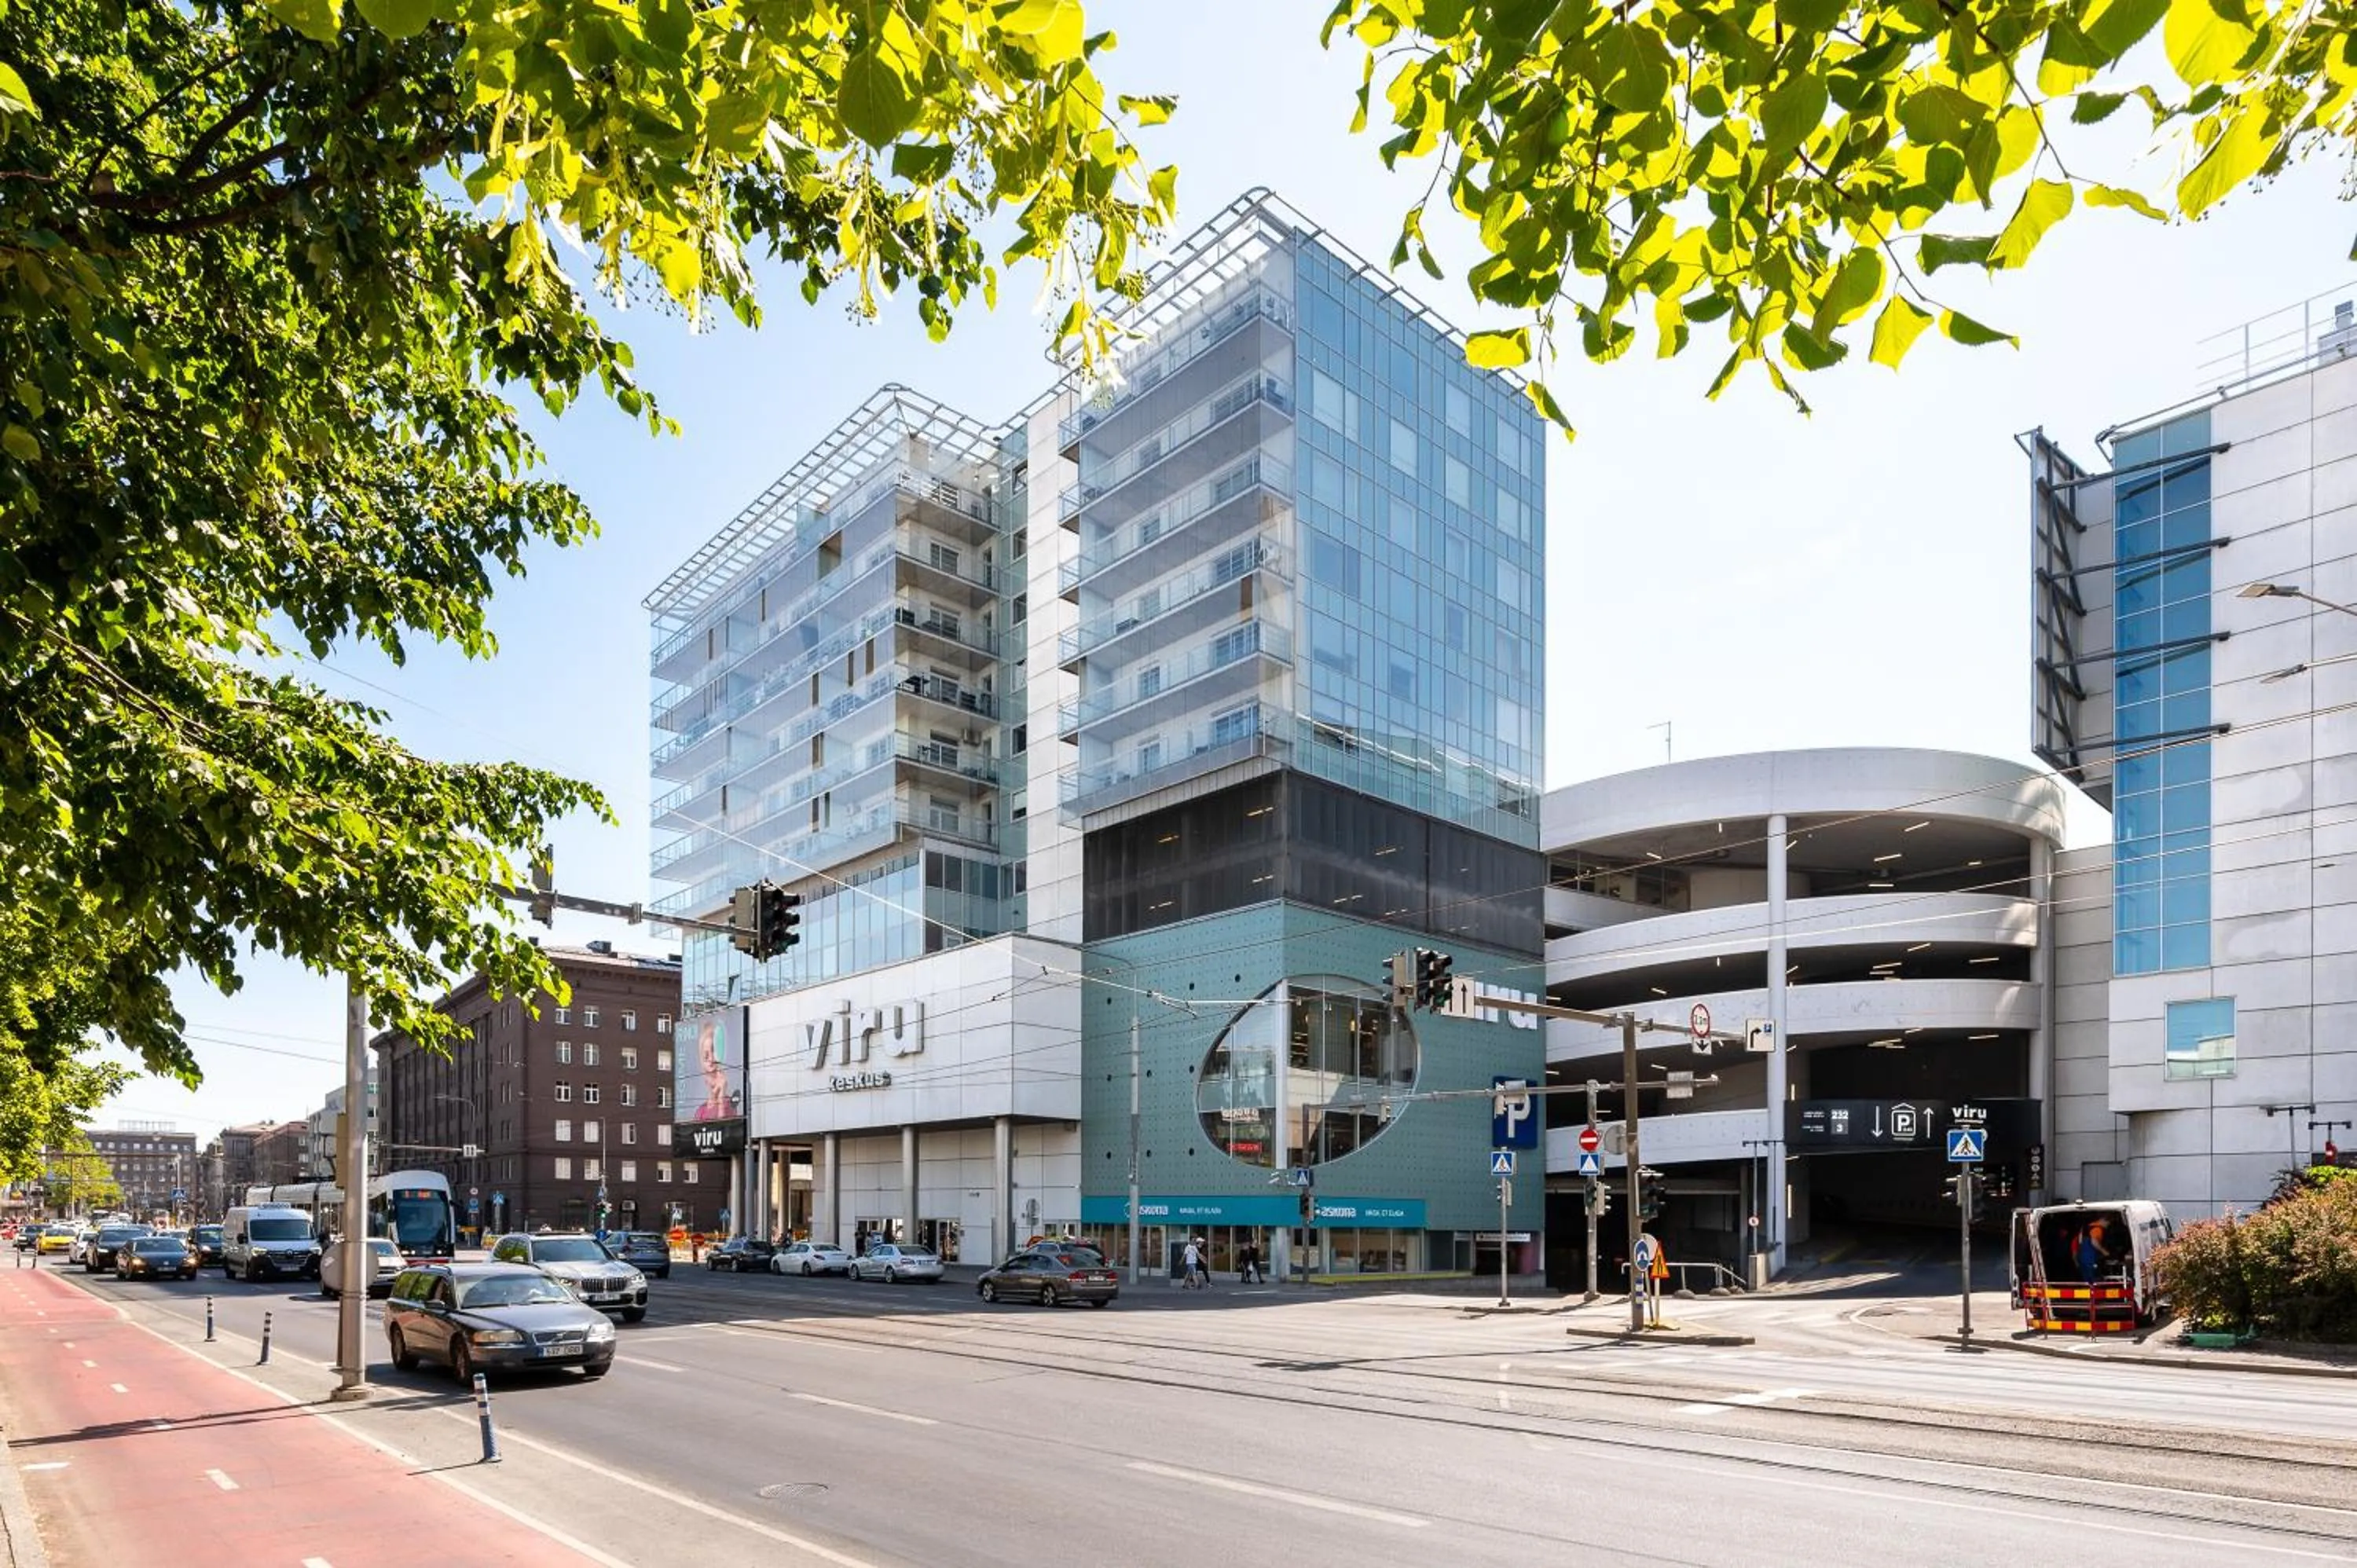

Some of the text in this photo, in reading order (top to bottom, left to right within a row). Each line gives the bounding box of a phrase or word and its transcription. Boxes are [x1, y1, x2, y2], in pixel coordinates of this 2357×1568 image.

[799, 998, 924, 1070] viru
[830, 1071, 892, 1092] keskus
[1508, 1089, 1531, 1138] P
[1952, 1105, 1987, 1119] viru
[1897, 1114, 1910, 1132] P
[694, 1127, 722, 1147] viru
